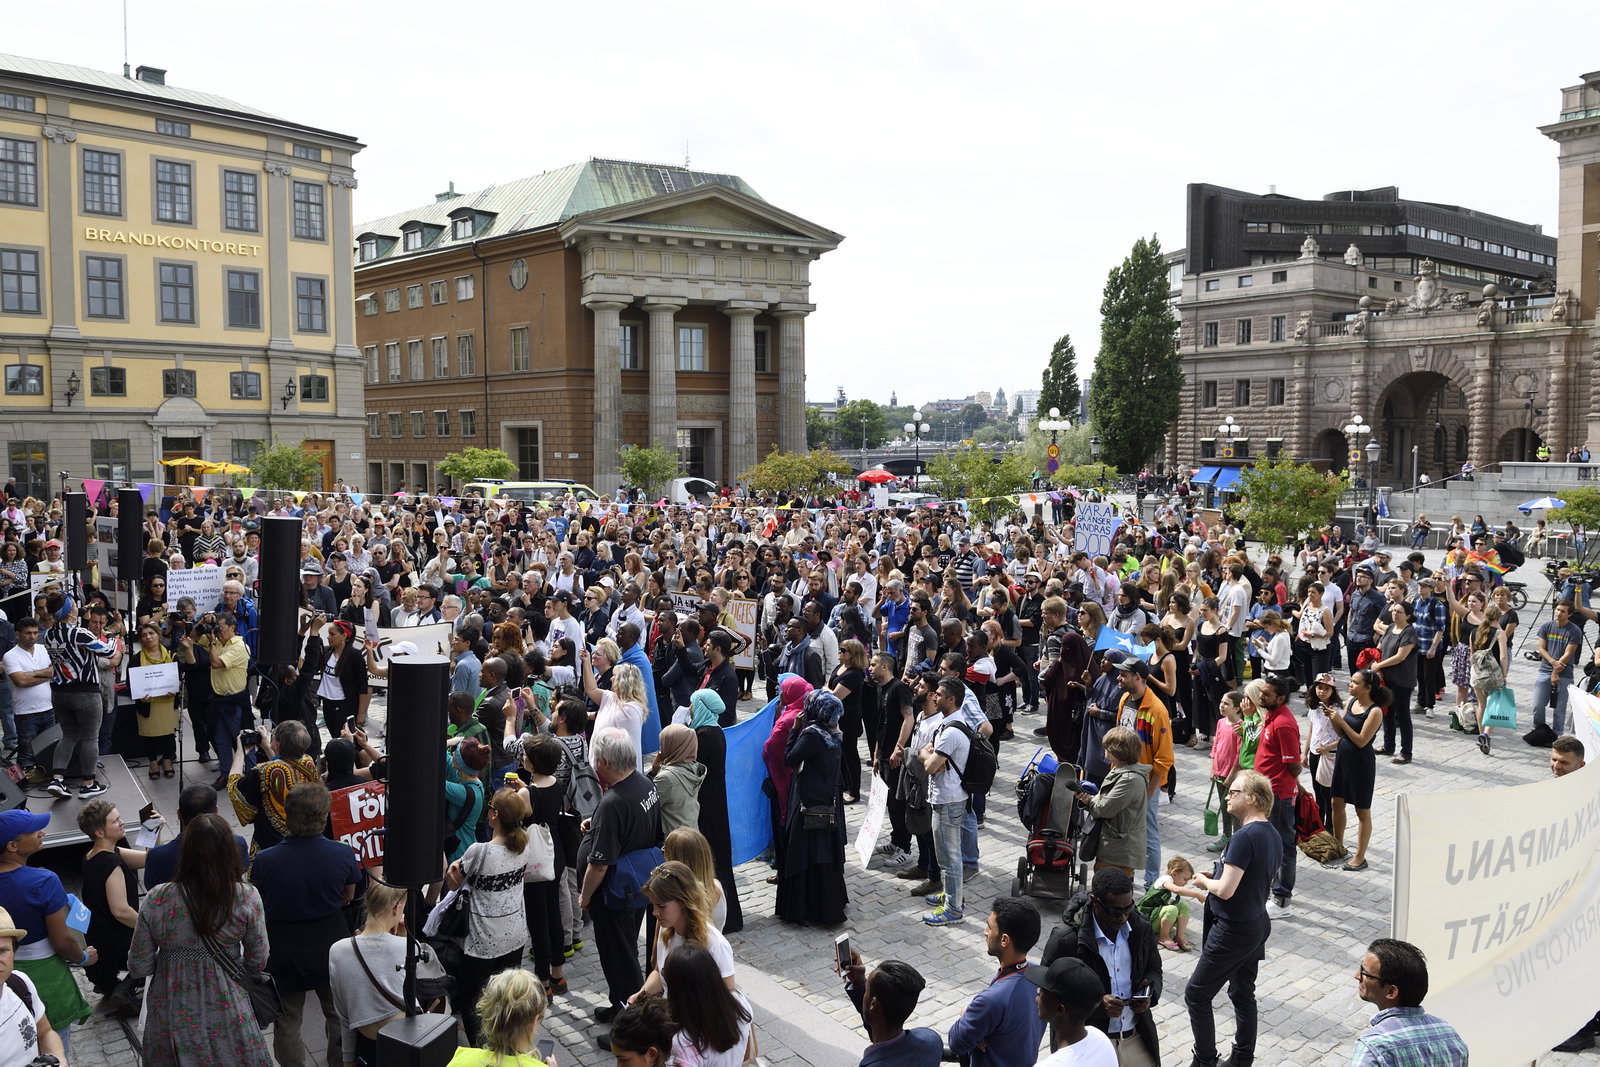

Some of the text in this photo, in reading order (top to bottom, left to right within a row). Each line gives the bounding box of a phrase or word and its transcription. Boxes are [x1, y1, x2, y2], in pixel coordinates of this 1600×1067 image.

[85, 227, 260, 257] BRANDKONTORET
[1076, 523, 1111, 535] ANDRAS
[673, 595, 684, 607] JA
